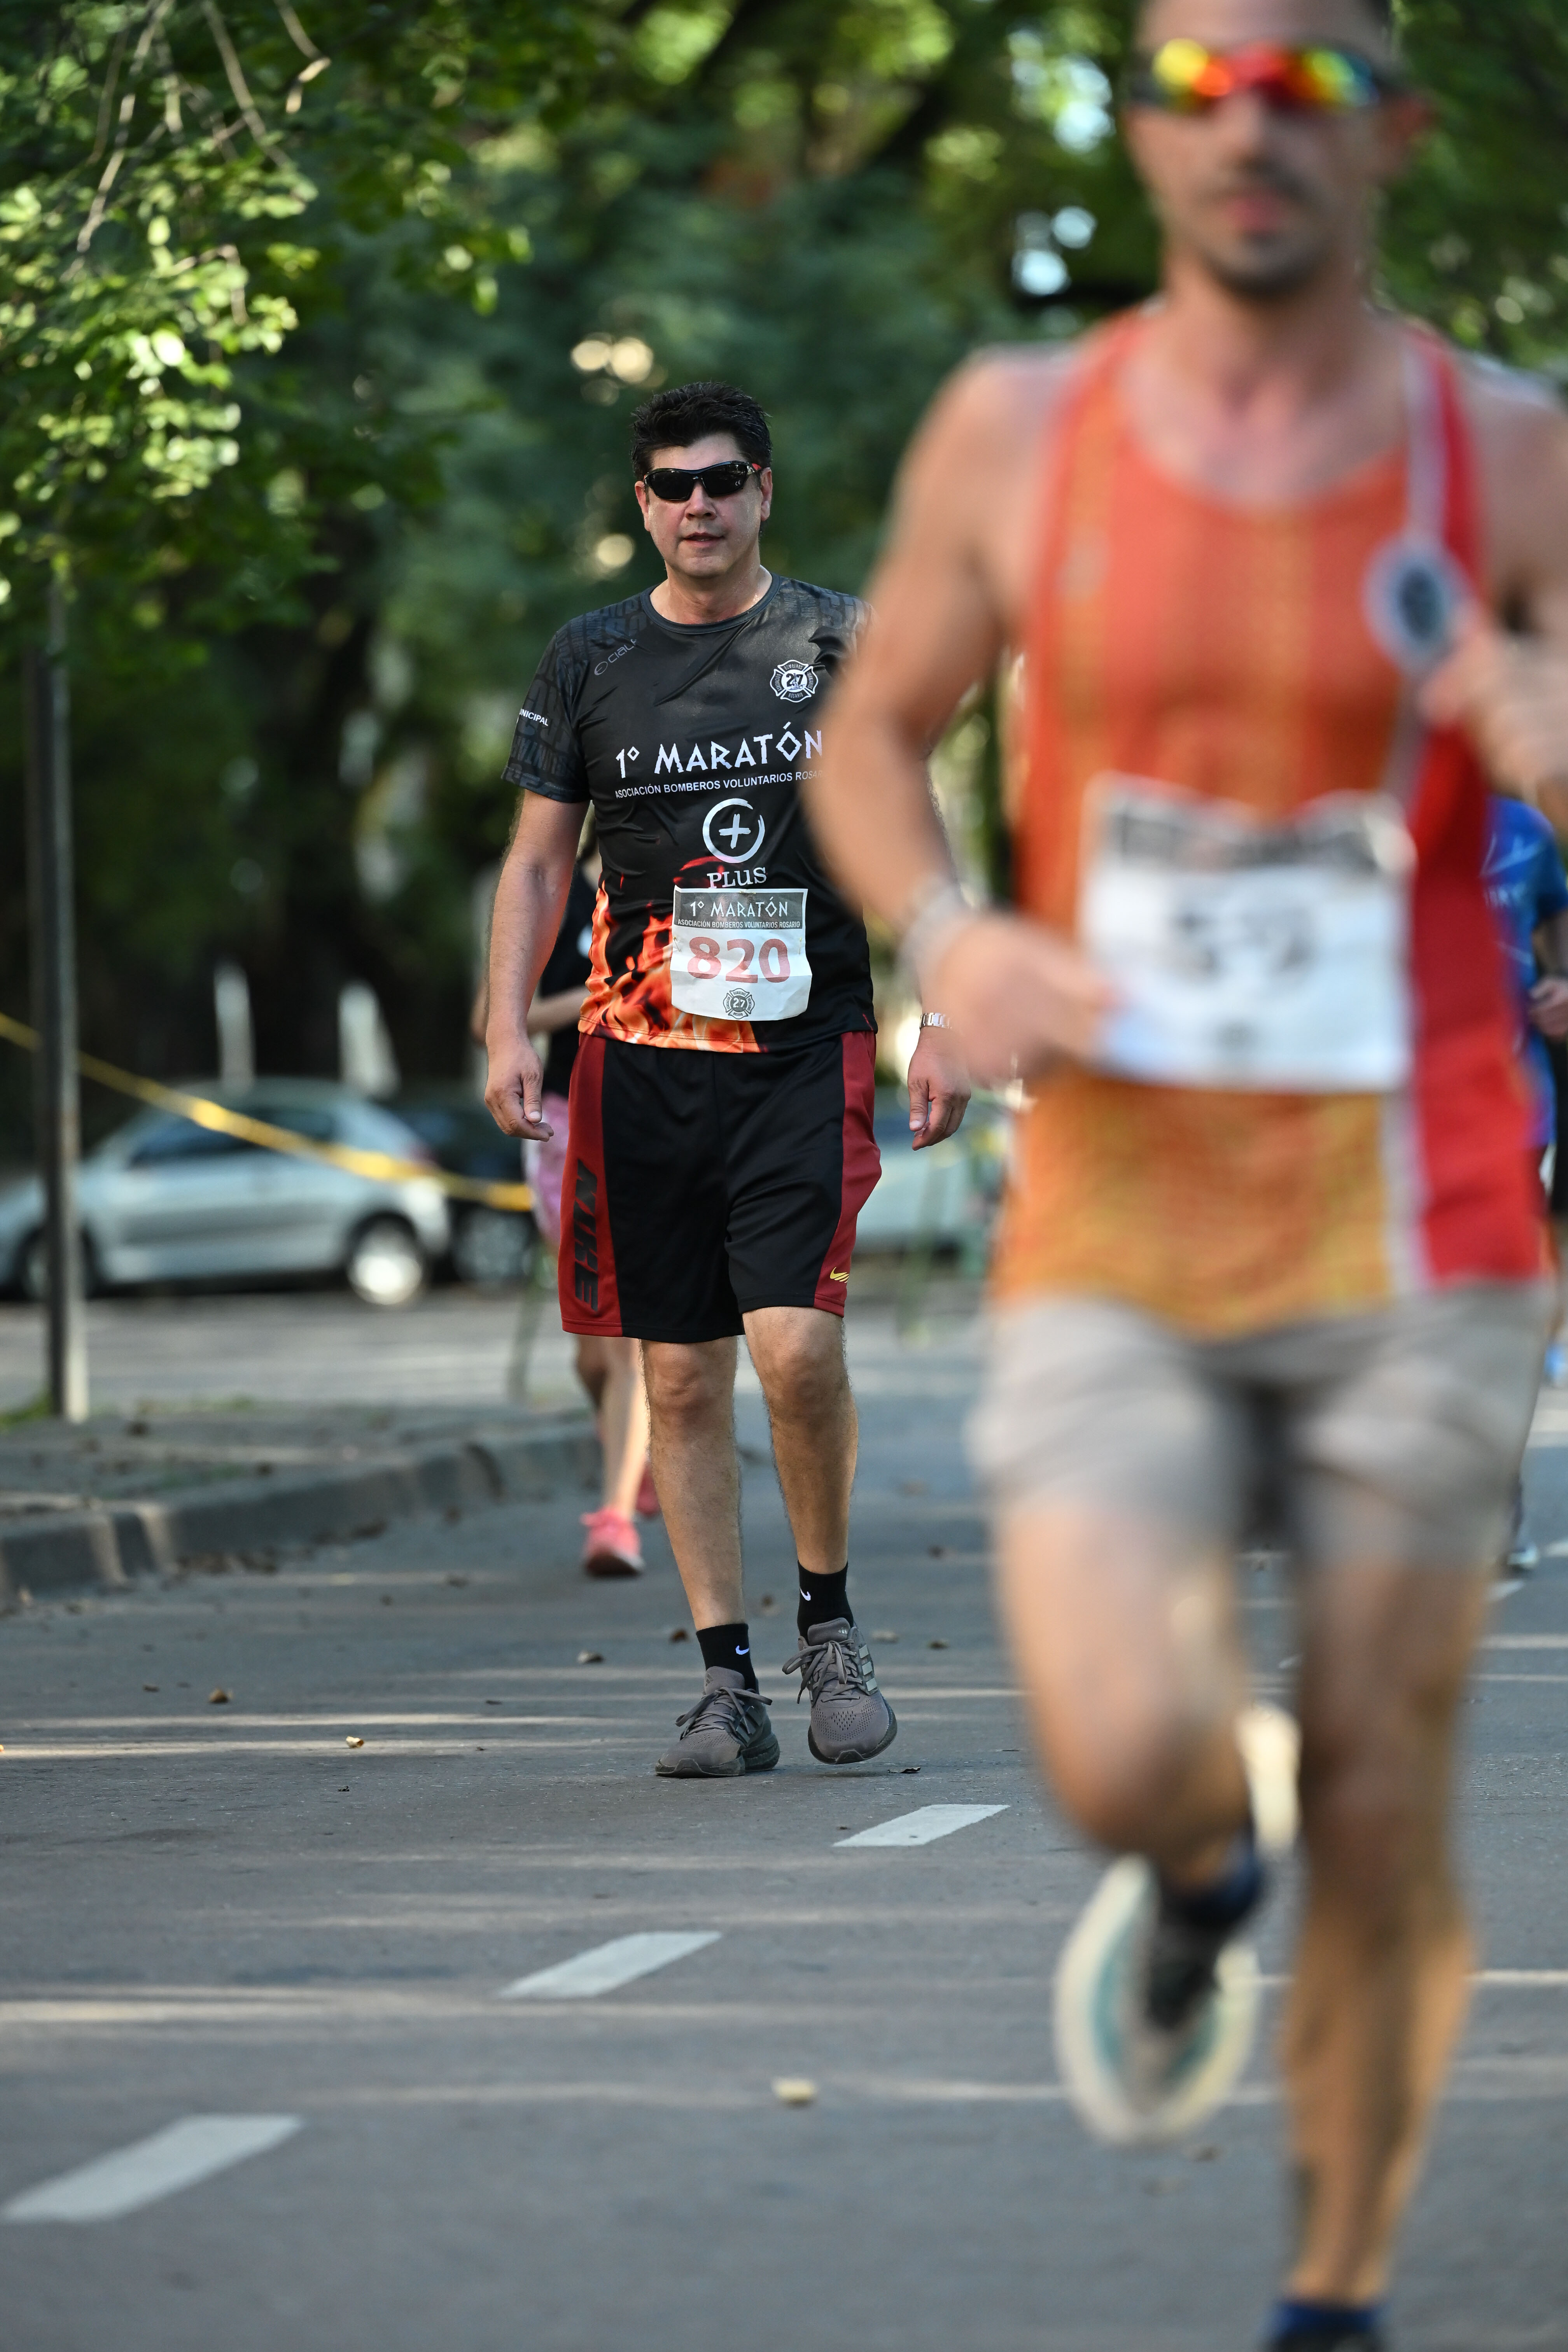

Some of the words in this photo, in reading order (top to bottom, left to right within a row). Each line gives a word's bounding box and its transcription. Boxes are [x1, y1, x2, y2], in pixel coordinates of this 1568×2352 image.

[786, 673, 803, 687] 27
[654, 721, 822, 774] MARATÓN
[615, 783, 661, 799] ASOCIACIÓN
[664, 779, 721, 793] BOMBEROS
[723, 772, 793, 789] VOLUNTARIOS
[710, 896, 788, 917] MARATÓN
[678, 918, 710, 928] ASOCIACIÓN
[687, 936, 791, 983] 820
[733, 997, 746, 1008] 27
[573, 1158, 599, 1312] NIKE
